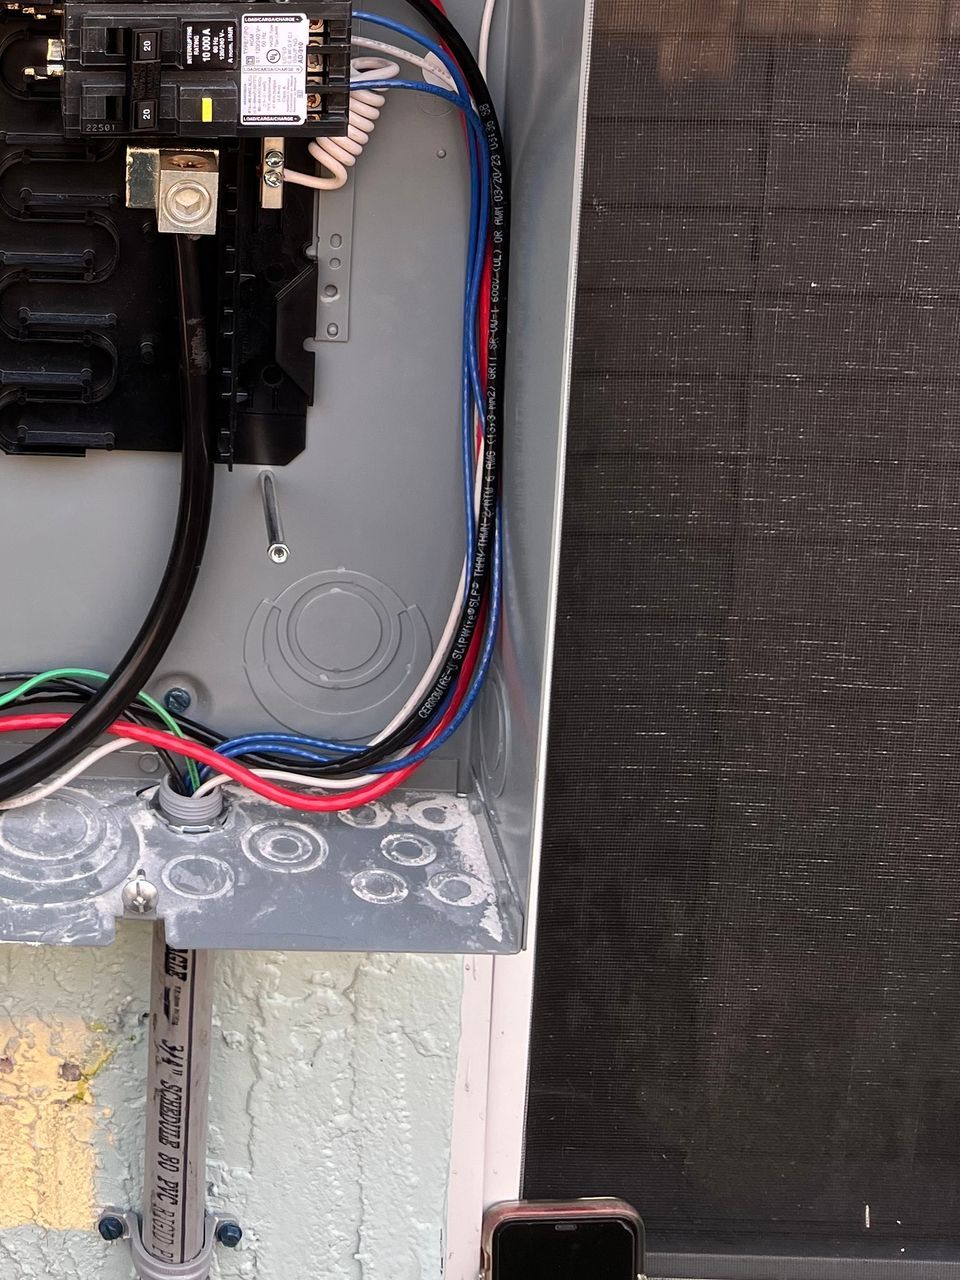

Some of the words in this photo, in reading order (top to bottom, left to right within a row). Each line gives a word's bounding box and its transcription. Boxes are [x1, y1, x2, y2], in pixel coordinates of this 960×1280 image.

[143, 40, 151, 52] 20
[202, 36, 211, 51] 000
[213, 37, 219, 45] Hz
[202, 52, 211, 62] 10
[142, 108, 151, 120] 20
[490, 154, 504, 202] 03/20/23
[493, 231, 503, 243] OR
[160, 1039, 184, 1076] 3/4"
[158, 1080, 182, 1149] SCHEDULE
[157, 1152, 180, 1173] 80
[156, 1176, 179, 1206] PVC
[151, 1204, 175, 1245] RIGID
